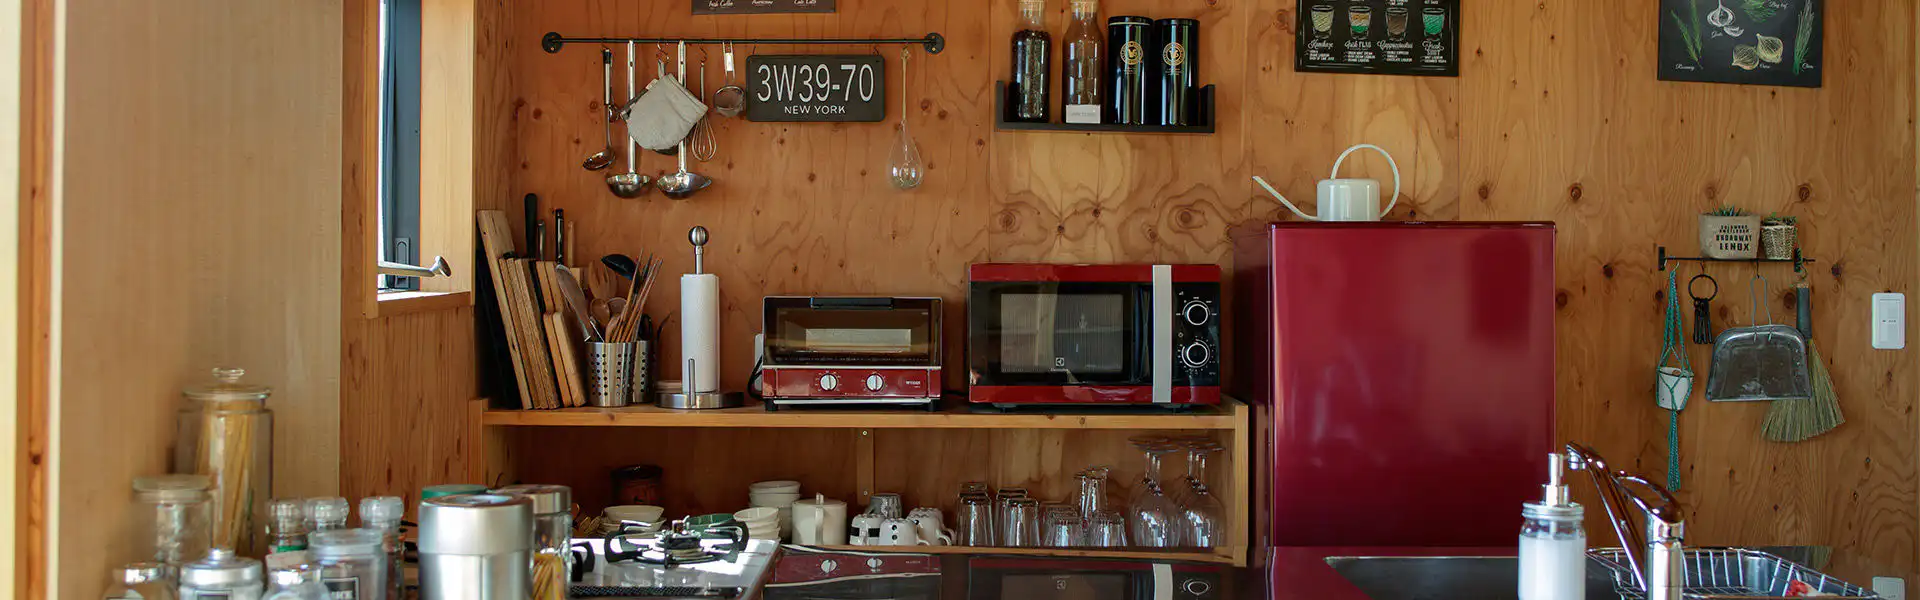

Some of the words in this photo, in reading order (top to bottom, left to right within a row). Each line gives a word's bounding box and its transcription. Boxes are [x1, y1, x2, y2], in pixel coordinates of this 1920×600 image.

[757, 63, 875, 103] 3W39-70
[784, 105, 811, 115] NEW
[813, 105, 846, 115] YORK
[1715, 234, 1752, 242] BROADWAY
[1719, 242, 1750, 251] LENOX
